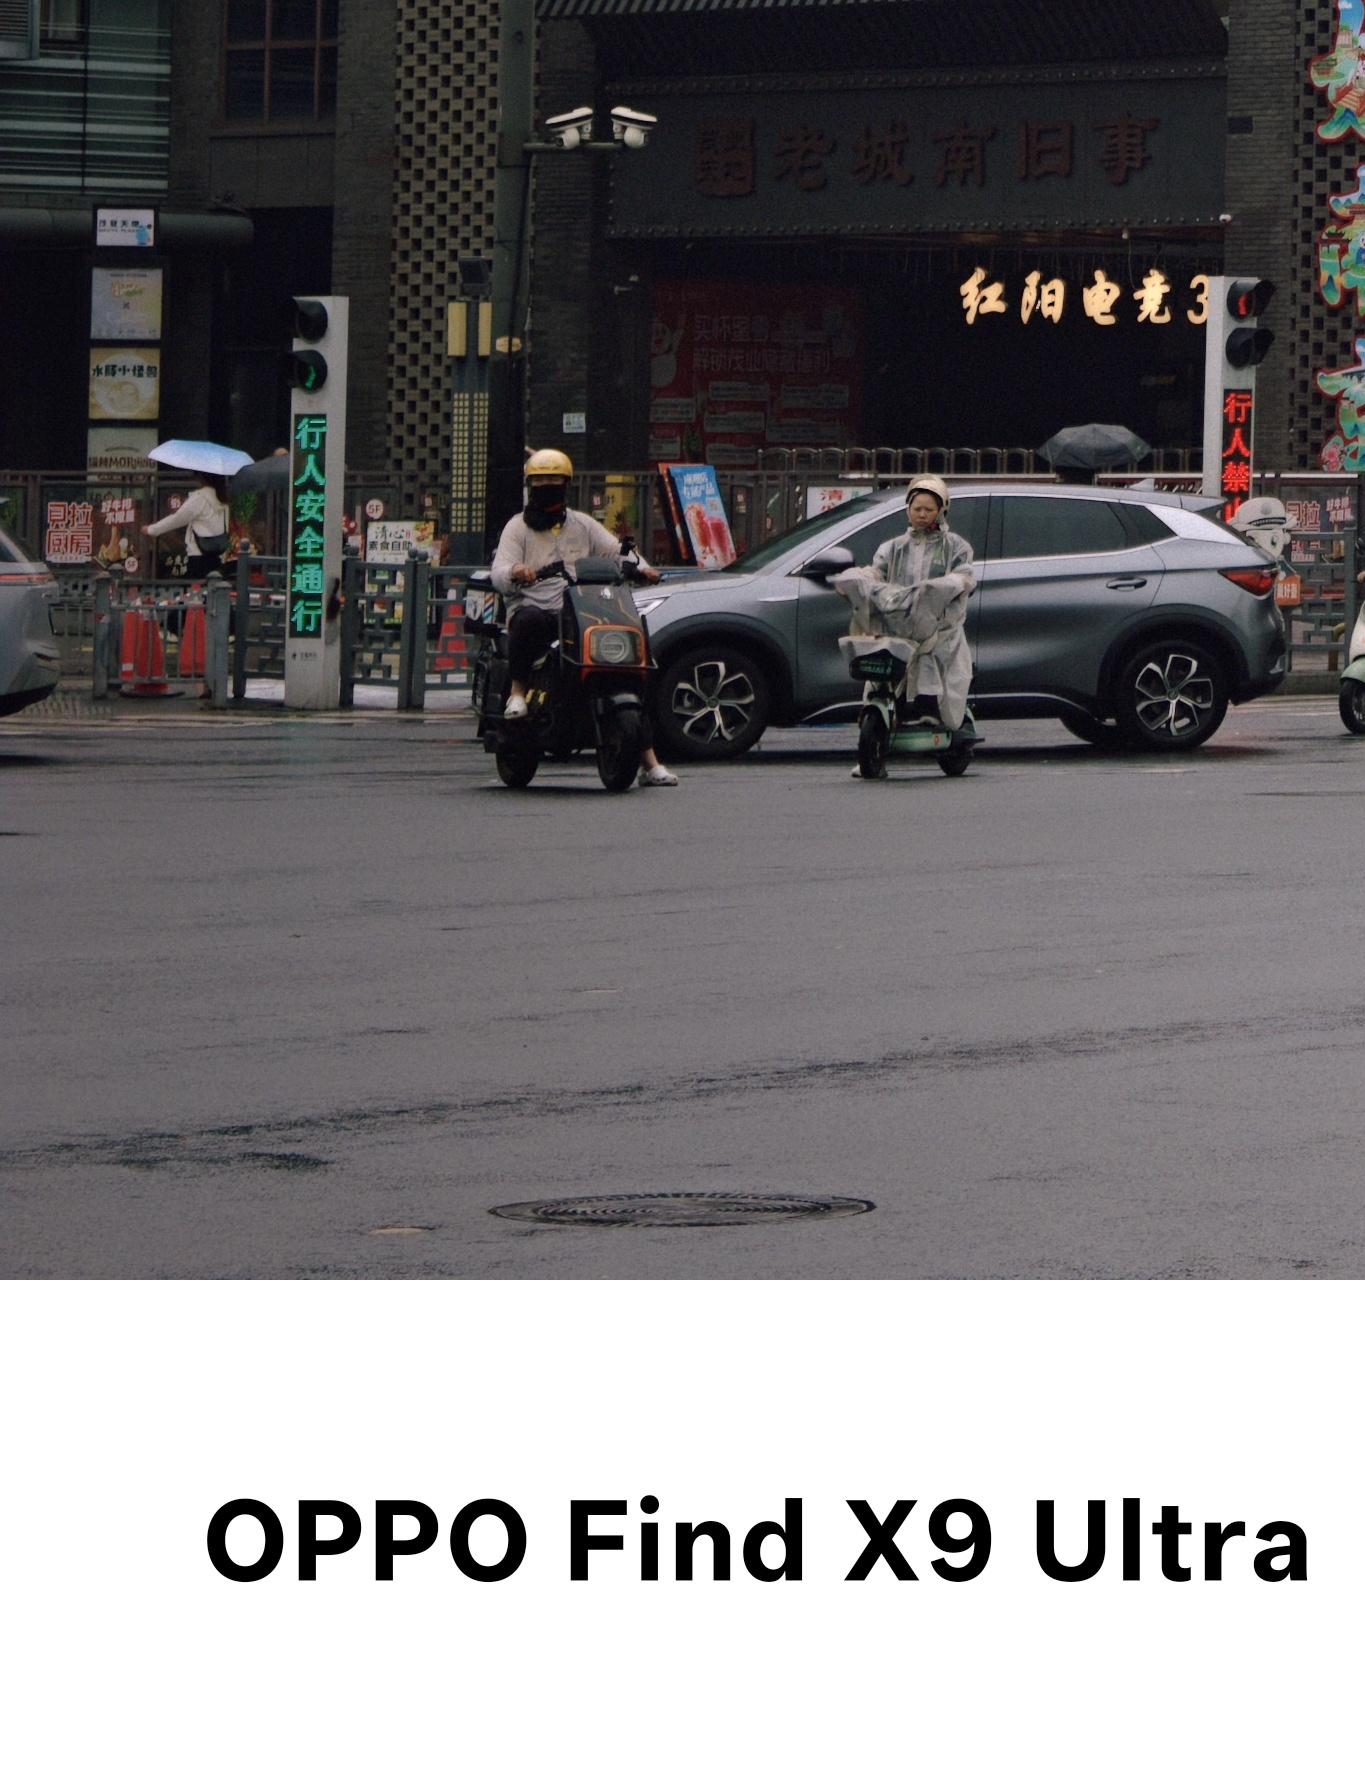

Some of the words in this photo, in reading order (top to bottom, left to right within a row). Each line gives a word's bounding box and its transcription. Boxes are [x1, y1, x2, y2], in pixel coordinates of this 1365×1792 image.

[773, 111, 1161, 191] 老城南旧事
[960, 267, 1209, 326] 红阳电竞3
[291, 416, 327, 633] 行人安全通行
